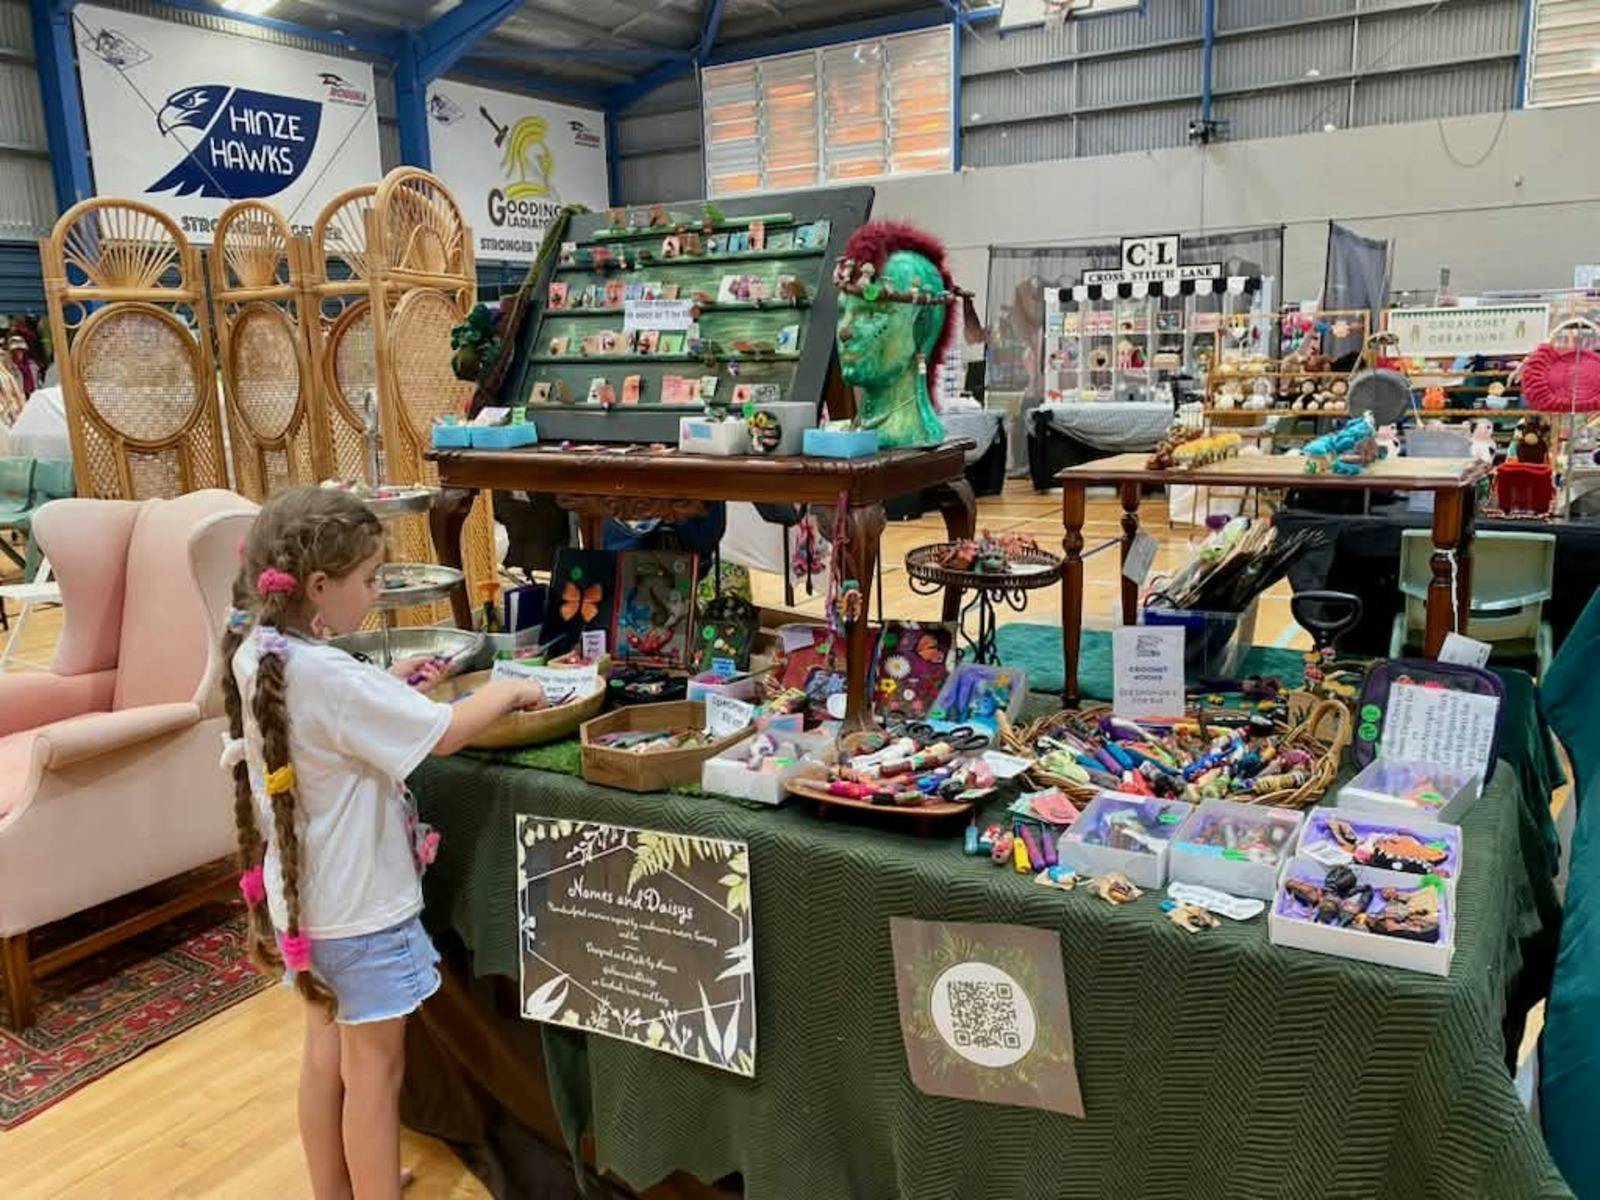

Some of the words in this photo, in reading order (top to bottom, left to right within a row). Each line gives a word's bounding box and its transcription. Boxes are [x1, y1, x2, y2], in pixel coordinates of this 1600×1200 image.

[229, 105, 305, 142] HINZE
[210, 136, 295, 176] HAWKS
[480, 237, 534, 253] STRONGER
[1088, 271, 1125, 284] CROSS
[1131, 269, 1175, 281] STITCH
[1181, 267, 1213, 279] LANE
[567, 875, 613, 905] Nomes
[616, 887, 643, 911] and
[641, 887, 693, 925] Daisys
